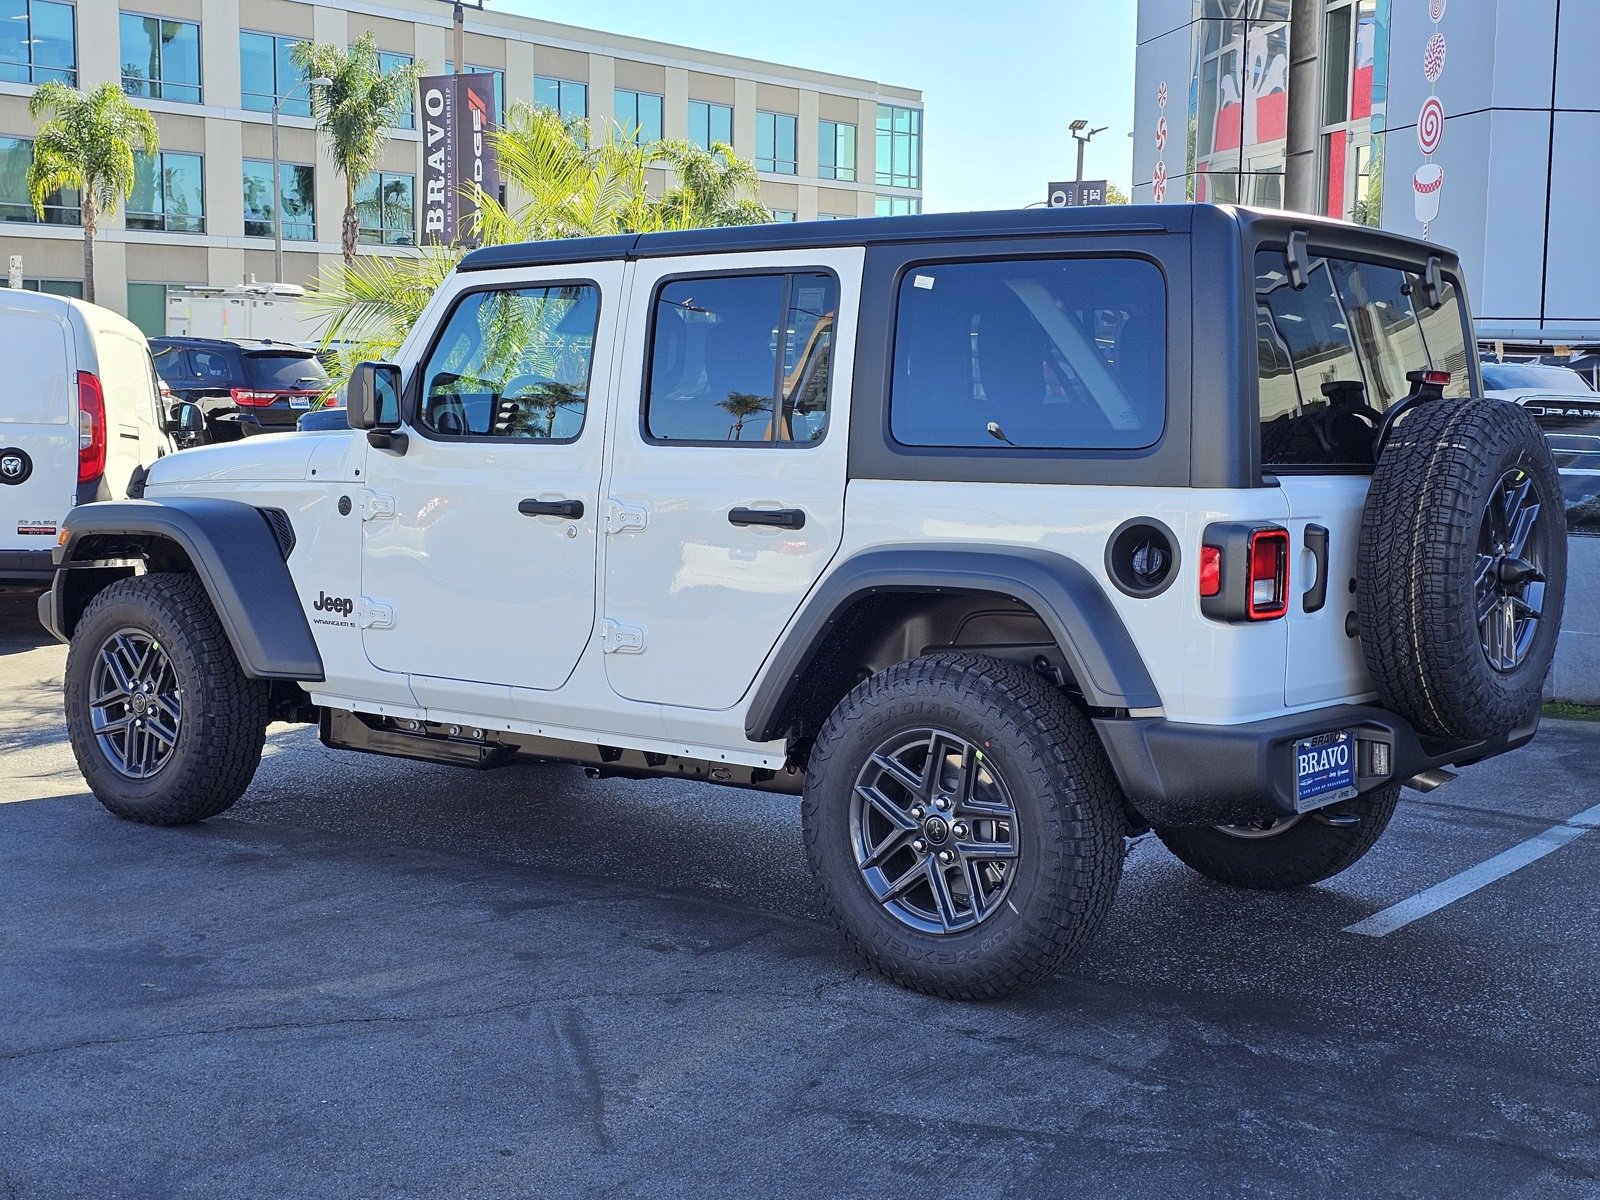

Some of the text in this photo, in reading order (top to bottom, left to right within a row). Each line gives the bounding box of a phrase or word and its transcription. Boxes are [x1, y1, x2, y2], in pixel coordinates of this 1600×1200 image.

[425, 88, 445, 233] BRAVO
[447, 155, 452, 168] OF
[313, 590, 353, 618] Jeep
[313, 618, 349, 627] WRANGLER
[1298, 744, 1349, 777] BRAVO
